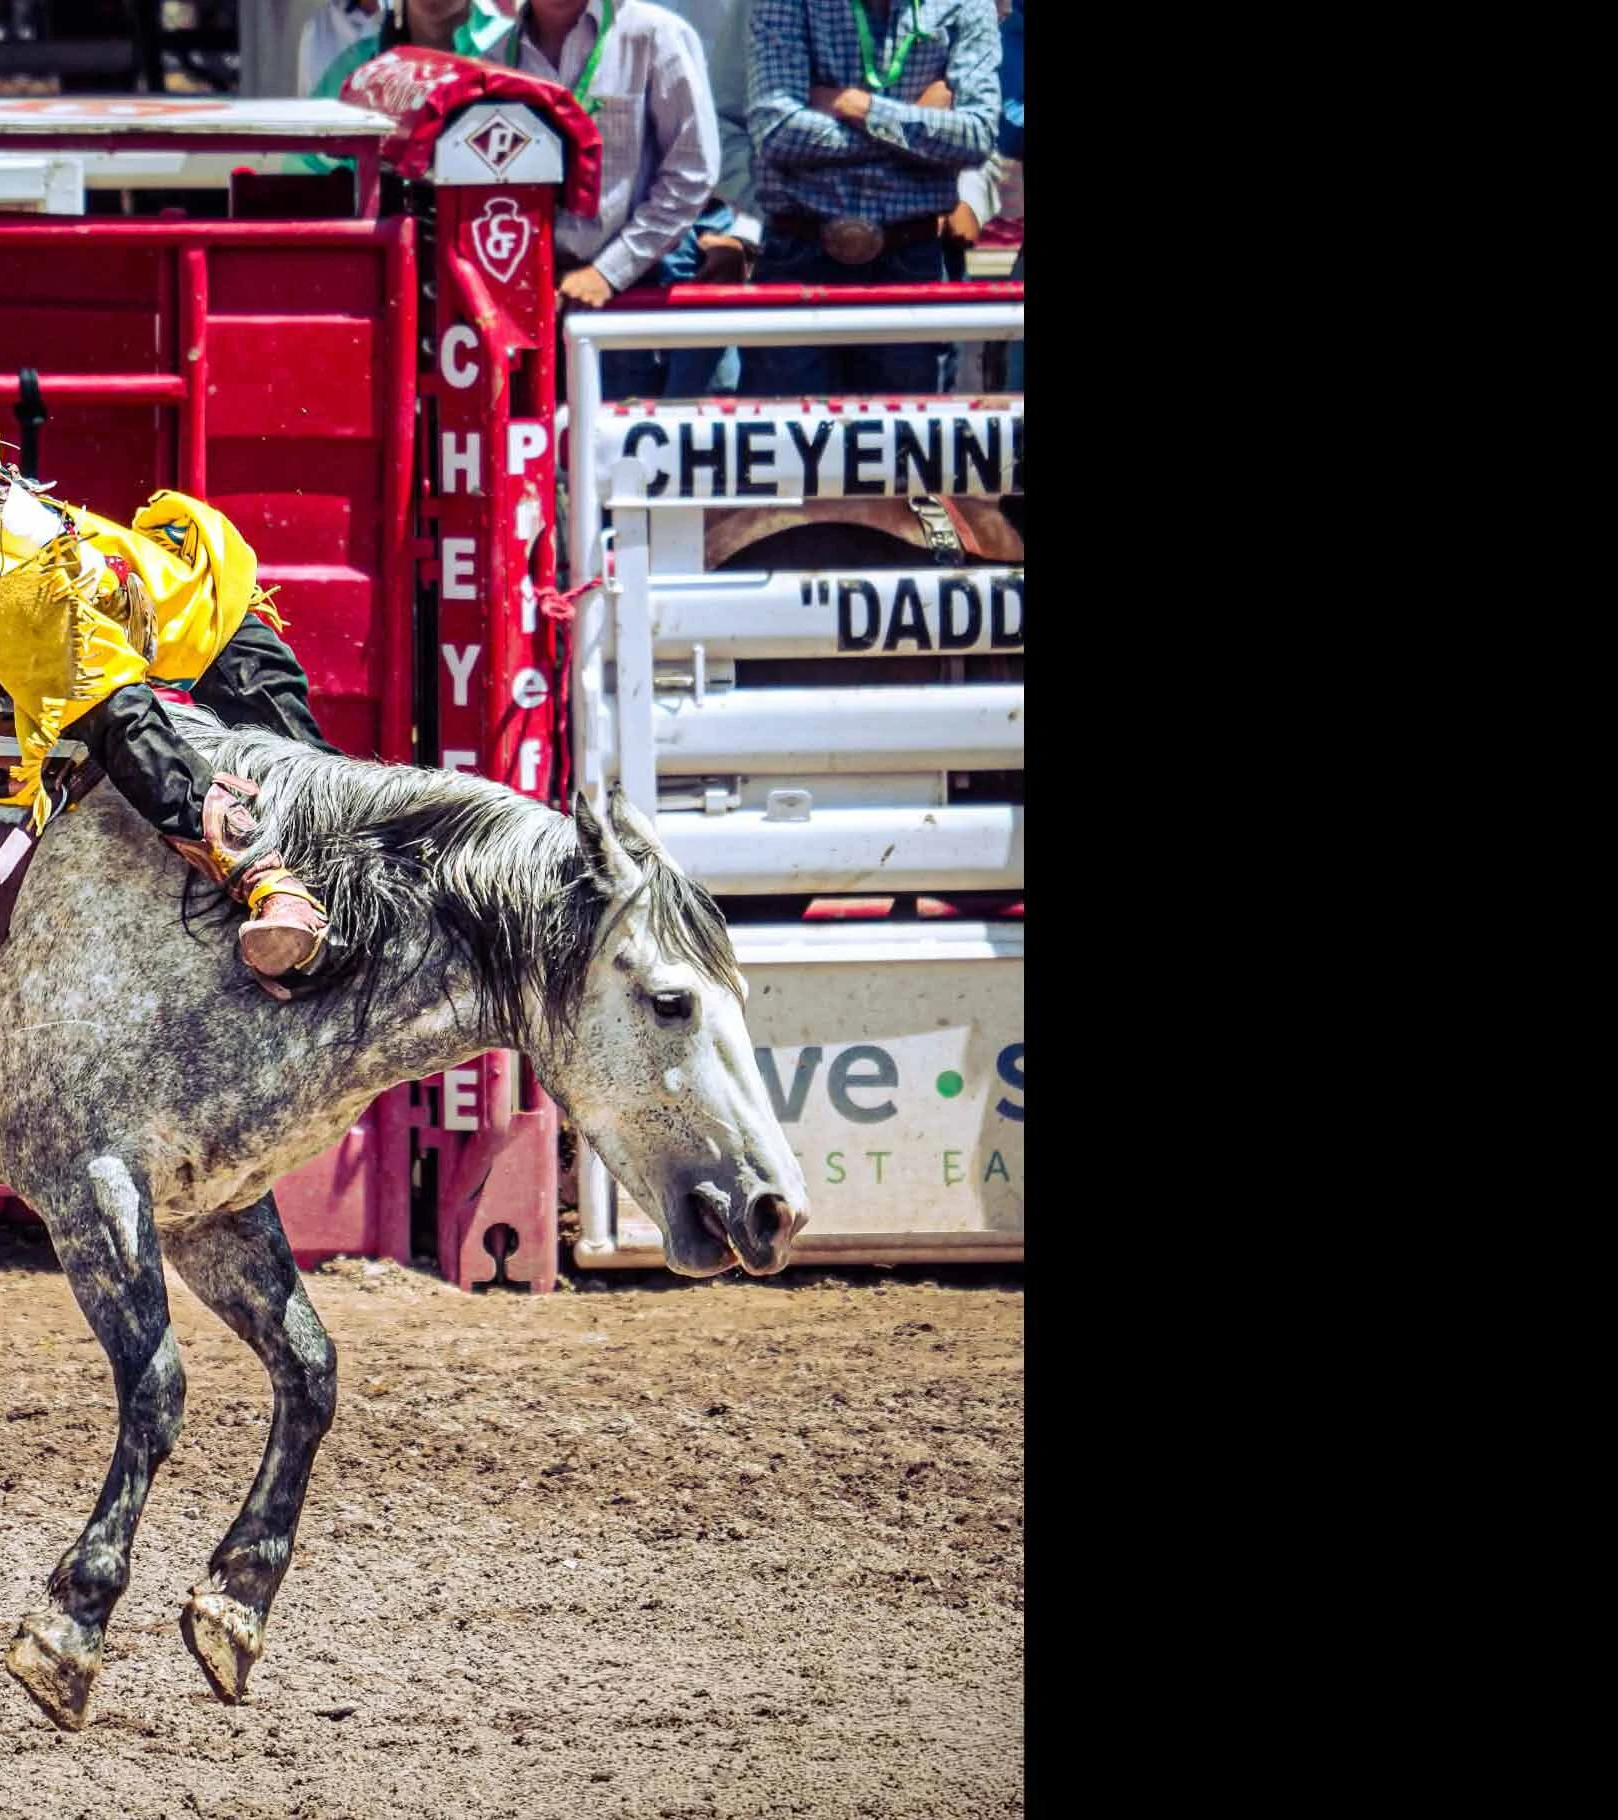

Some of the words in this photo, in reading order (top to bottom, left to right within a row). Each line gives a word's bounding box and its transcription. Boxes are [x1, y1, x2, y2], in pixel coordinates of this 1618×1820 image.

[621, 420, 1024, 498] CHEYENN
[440, 324, 480, 1131] CHEYE
[794, 1150, 892, 1185] ST
